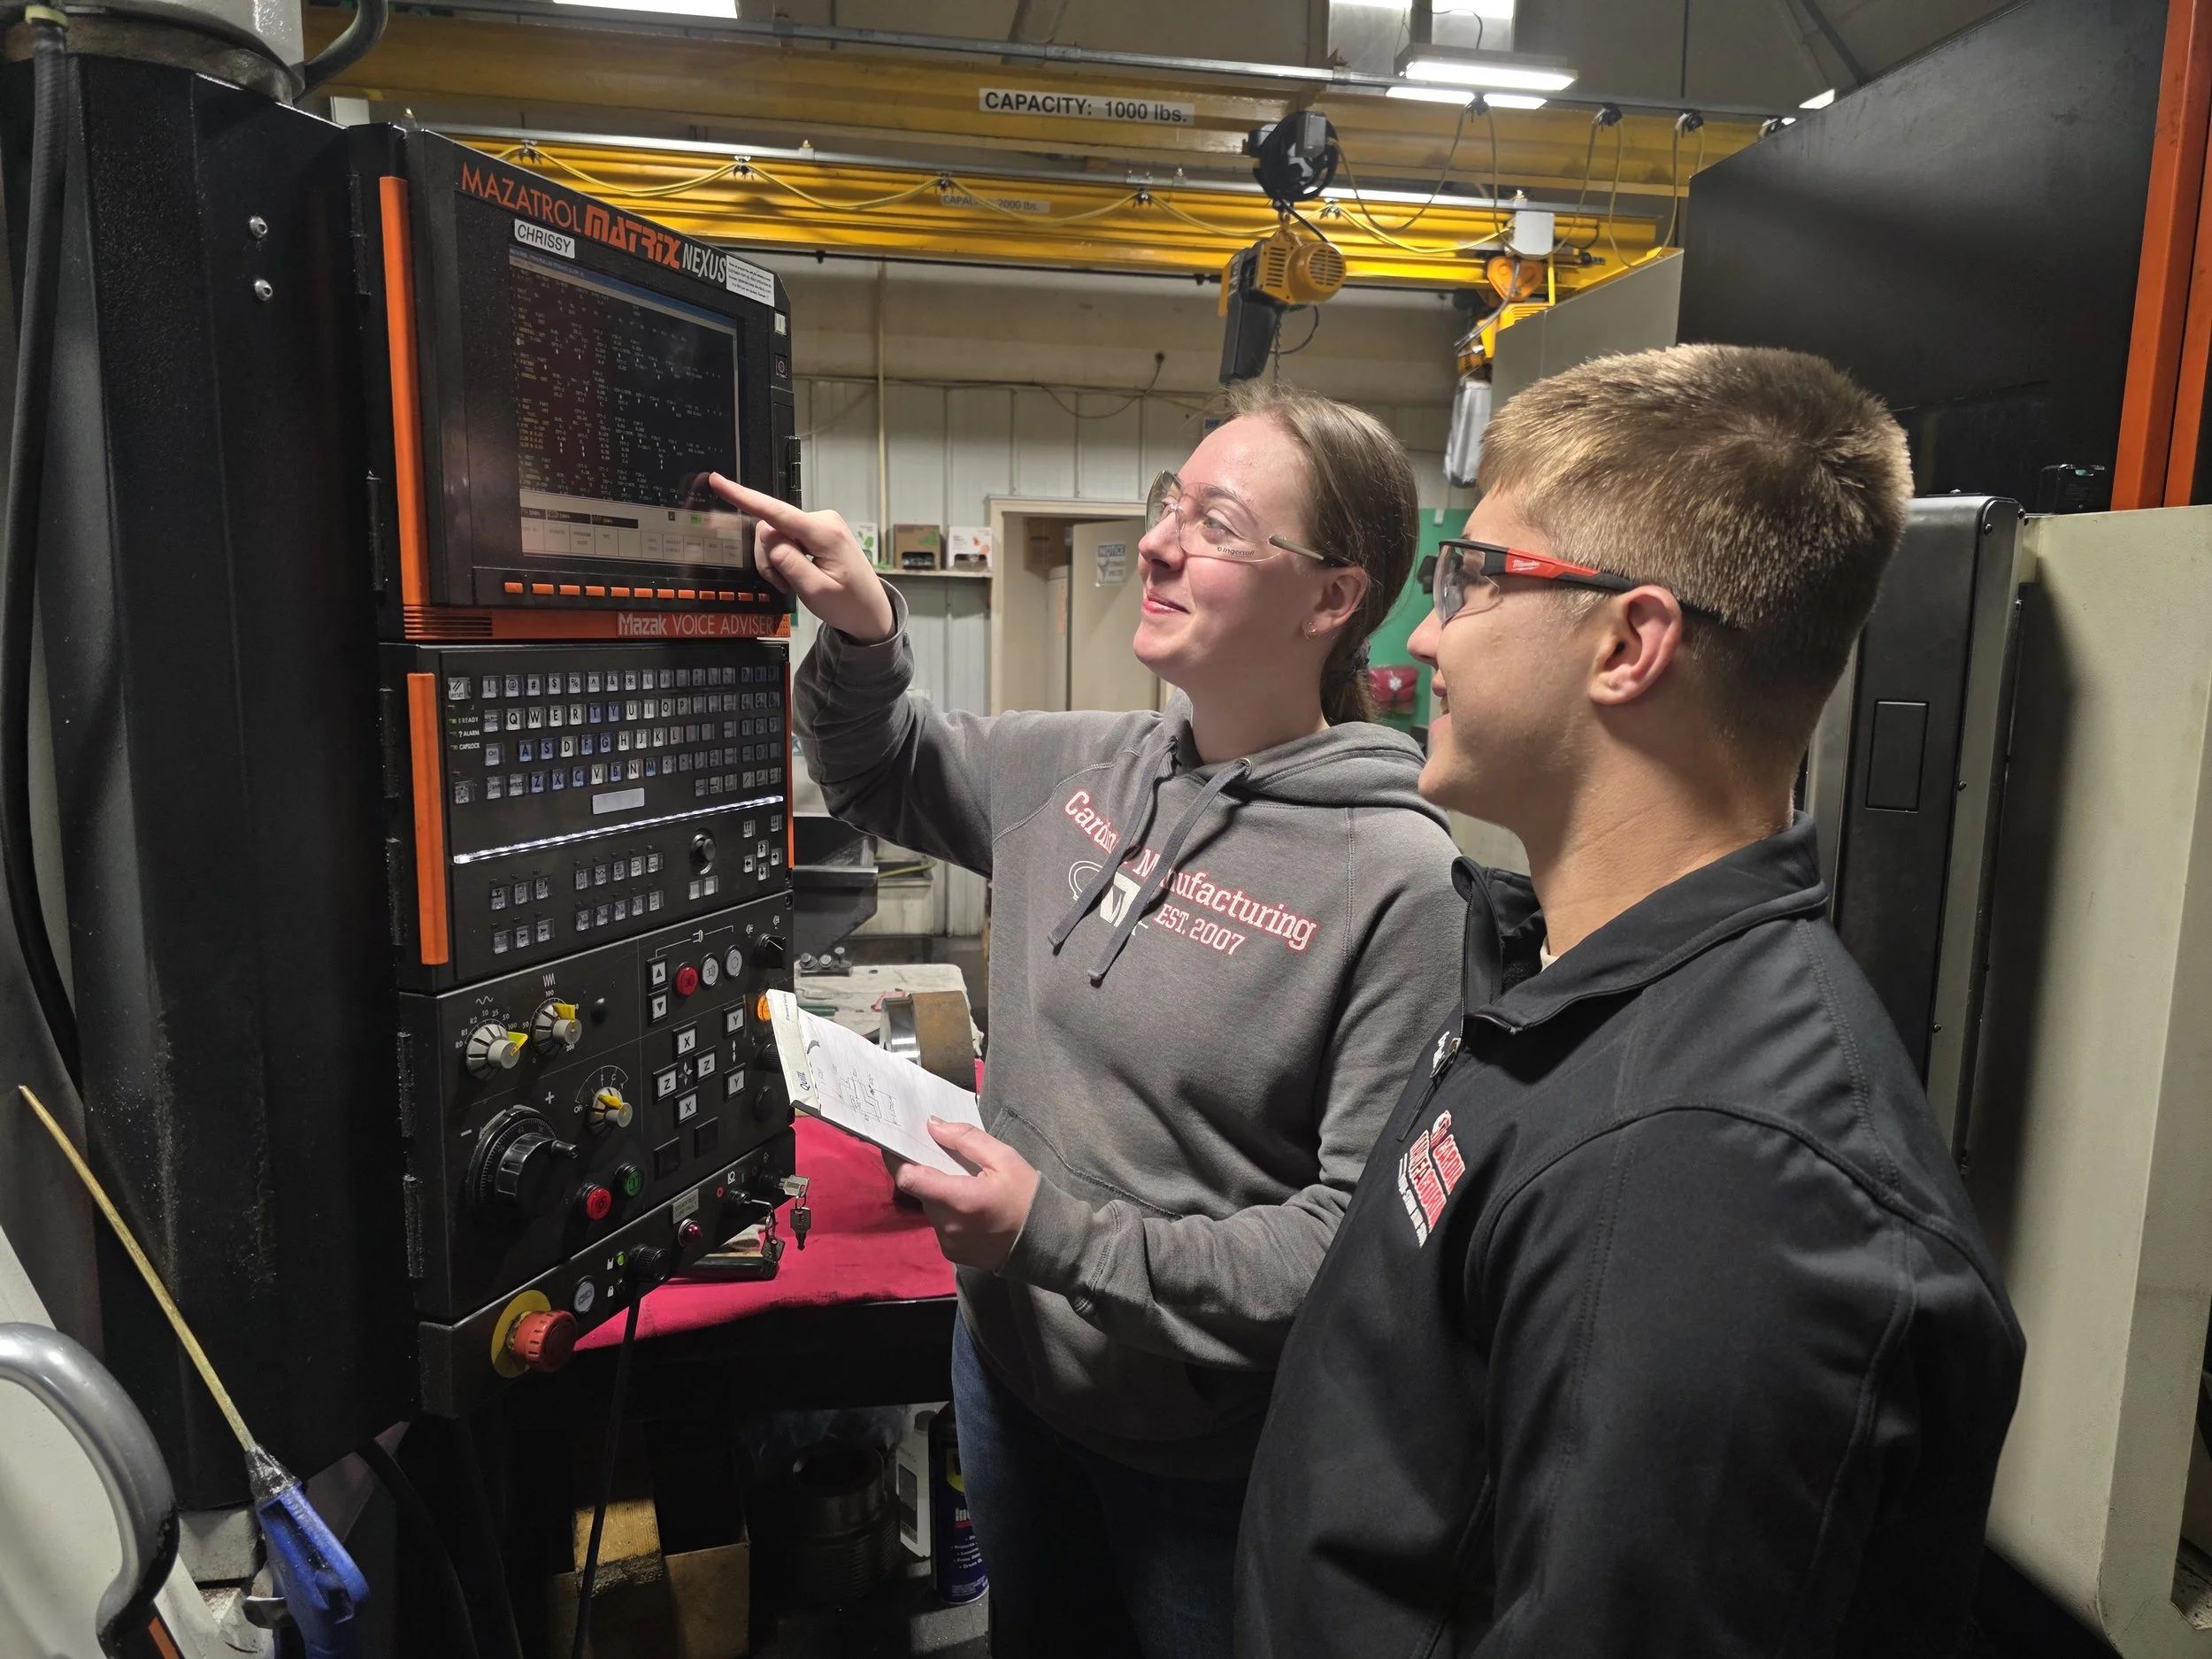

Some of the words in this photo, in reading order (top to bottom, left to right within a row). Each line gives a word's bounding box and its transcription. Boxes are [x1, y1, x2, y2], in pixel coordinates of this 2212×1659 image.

[984, 91, 1093, 117] CAPACITY:
[1104, 100, 1148, 120] 1000
[1154, 104, 1187, 123] lbs.
[997, 199, 1022, 211] 2000
[461, 162, 581, 234] MAZATROL
[583, 204, 680, 270] MATRIX
[682, 245, 726, 283] NEXUS
[517, 223, 572, 253] CHRISSY
[618, 614, 668, 636] Mazak
[672, 616, 715, 635] VOICE
[720, 615, 774, 636] ADVISER
[509, 713, 518, 725] Q
[528, 711, 540, 723] W
[554, 710, 558, 720] E
[573, 709, 579, 719] R
[592, 707, 598, 718] T
[611, 706, 617, 718] Y
[629, 704, 634, 716] U
[663, 702, 668, 713] O
[521, 744, 529, 757] A
[544, 742, 550, 754] S
[565, 741, 570, 752] D
[602, 737, 609, 749] G
[620, 735, 626, 746] H
[656, 732, 661, 741] K
[534, 775, 541, 787] Z
[555, 772, 560, 786] X
[574, 771, 580, 782] C
[594, 768, 600, 780] V
[630, 763, 637, 774] N
[647, 760, 654, 772] M
[1133, 848, 1317, 951] Mnufacturing
[1154, 903, 1188, 936] EST.
[1189, 918, 1247, 956] 2007
[545, 989, 555, 998] 100
[455, 1041, 464, 1049] R0
[461, 1028, 468, 1037] R1
[491, 1009, 500, 1018] 25
[508, 1022, 518, 1031] 100
[733, 1015, 739, 1025] Y
[684, 1036, 690, 1048] X
[703, 1060, 710, 1072] Z
[664, 1077, 672, 1091] Z
[733, 1077, 740, 1087] Y
[685, 1102, 692, 1113] X
